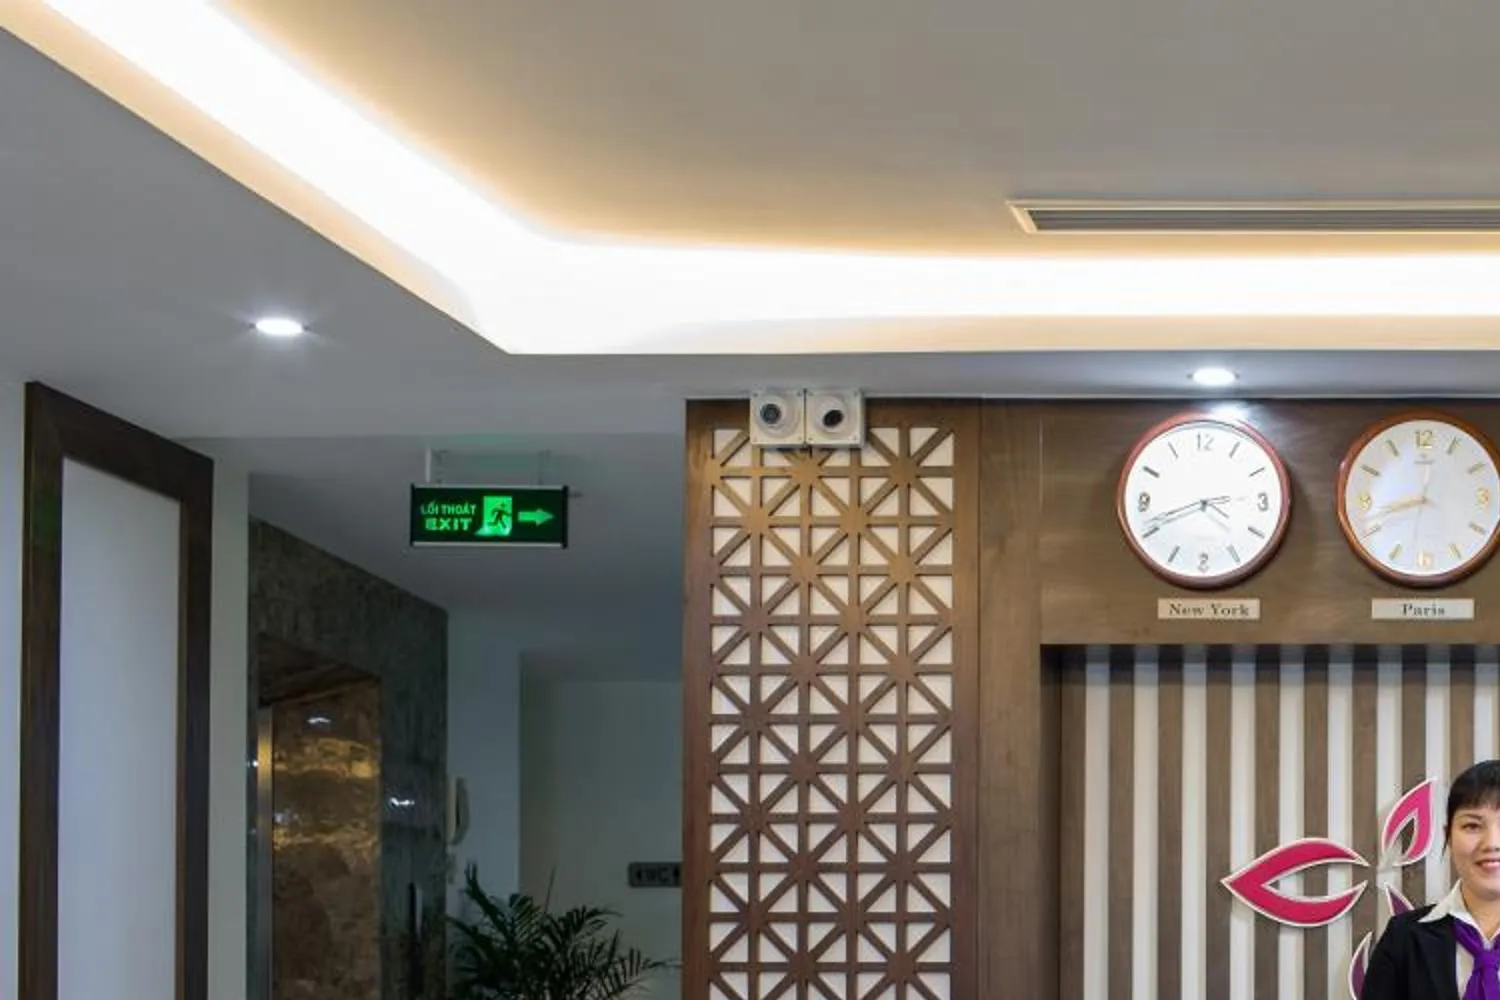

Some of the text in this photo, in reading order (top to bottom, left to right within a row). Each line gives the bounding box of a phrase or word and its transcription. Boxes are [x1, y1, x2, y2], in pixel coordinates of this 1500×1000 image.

[1257, 492, 1269, 512] 3
[425, 517, 472, 530] EXIT
[1169, 603, 1250, 617] New York
[1402, 603, 1446, 616] Paris
